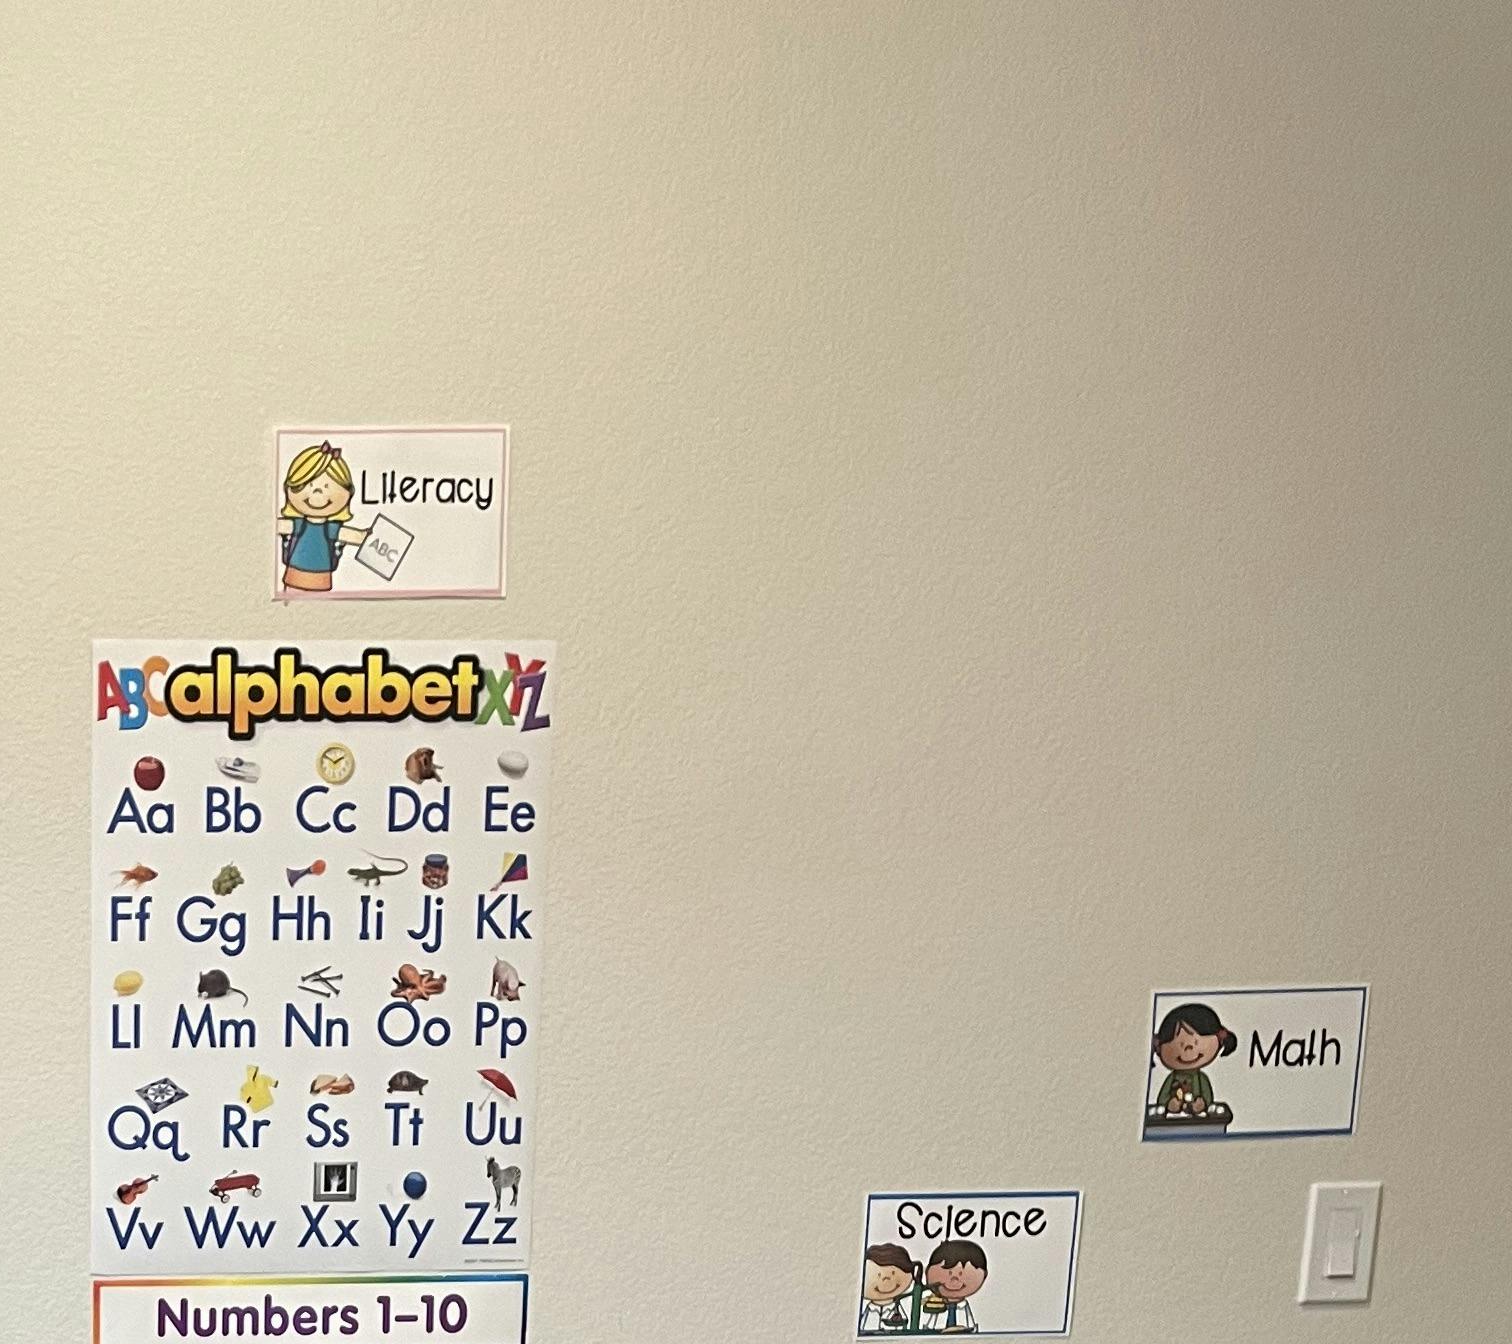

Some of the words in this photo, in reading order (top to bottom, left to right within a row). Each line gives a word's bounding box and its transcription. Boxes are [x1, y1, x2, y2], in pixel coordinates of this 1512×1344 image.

[361, 469, 494, 511] Literacy
[368, 537, 399, 563] ABC
[96, 654, 171, 732] ABC
[165, 646, 487, 741] alphabet
[474, 650, 550, 733] XYZ
[107, 788, 174, 834] Aa
[206, 786, 261, 833] Bb
[296, 786, 357, 833] Cc
[388, 785, 450, 832] Dd
[484, 786, 536, 832] Ee
[110, 895, 152, 942] Ff
[177, 894, 247, 956] Gg
[273, 894, 331, 941] Hh
[359, 895, 384, 940] Ii
[408, 893, 443, 953] Jj
[476, 893, 532, 940] Kk
[111, 1003, 141, 1048] Ll
[172, 1003, 256, 1048] Mm
[285, 1002, 349, 1047] Nn
[377, 1001, 451, 1047] Oo
[475, 1002, 527, 1058] Pp
[1248, 1028, 1342, 1069] Math
[107, 1105, 190, 1161] Qq
[223, 1104, 271, 1148] Rr
[306, 1103, 350, 1148] Ss
[385, 1101, 424, 1146] Tt
[465, 1101, 522, 1146] Uu
[106, 1207, 164, 1250] Vv
[184, 1205, 277, 1249] Ww
[297, 1204, 360, 1248] Xx
[379, 1203, 434, 1259] Yy
[461, 1201, 517, 1245] Zz
[896, 1201, 1048, 1243] Science
[156, 1294, 359, 1338] Numbers
